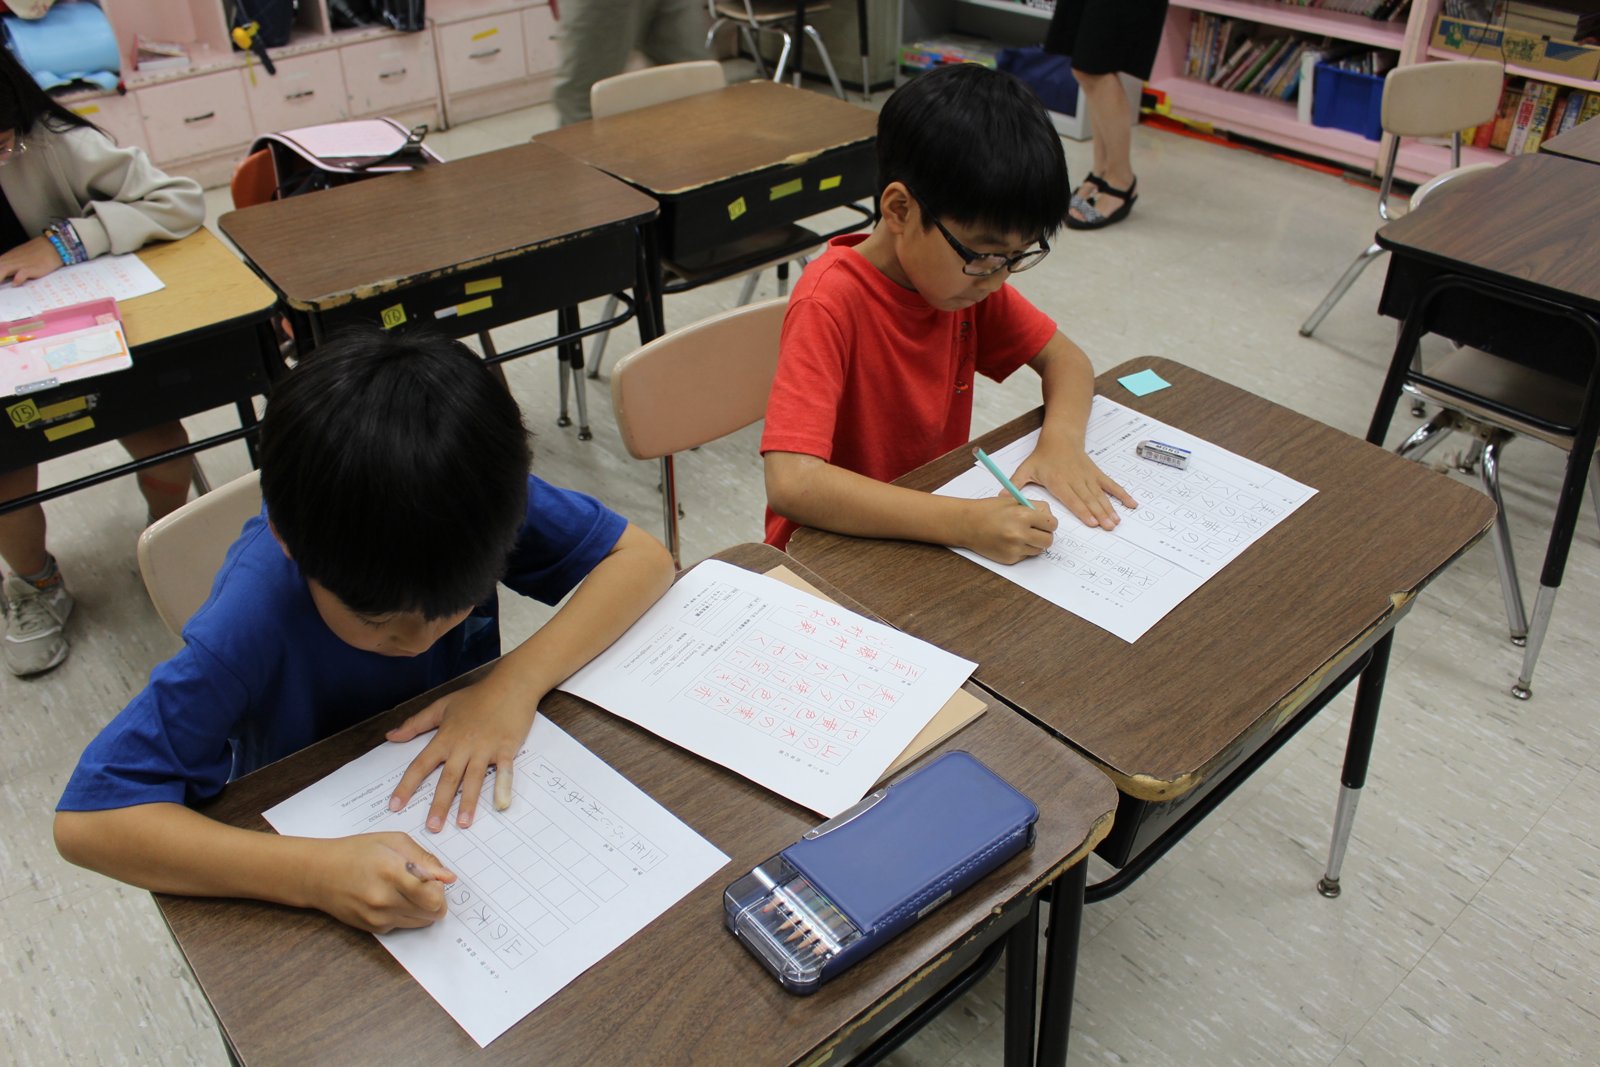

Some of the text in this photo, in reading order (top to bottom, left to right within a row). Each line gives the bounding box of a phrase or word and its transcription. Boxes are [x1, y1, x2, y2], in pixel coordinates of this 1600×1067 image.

[13, 406, 33, 422] 15
[1155, 444, 1180, 454] MONO
[732, 650, 878, 722] 秋の夕焼け空に
[754, 634, 897, 704] 美しくかがやく
[889, 658, 919, 678] 三年
[694, 684, 842, 758] 山の木の葉が赤
[713, 667, 859, 740] や黄色に色付き
[630, 839, 658, 863] 三年
